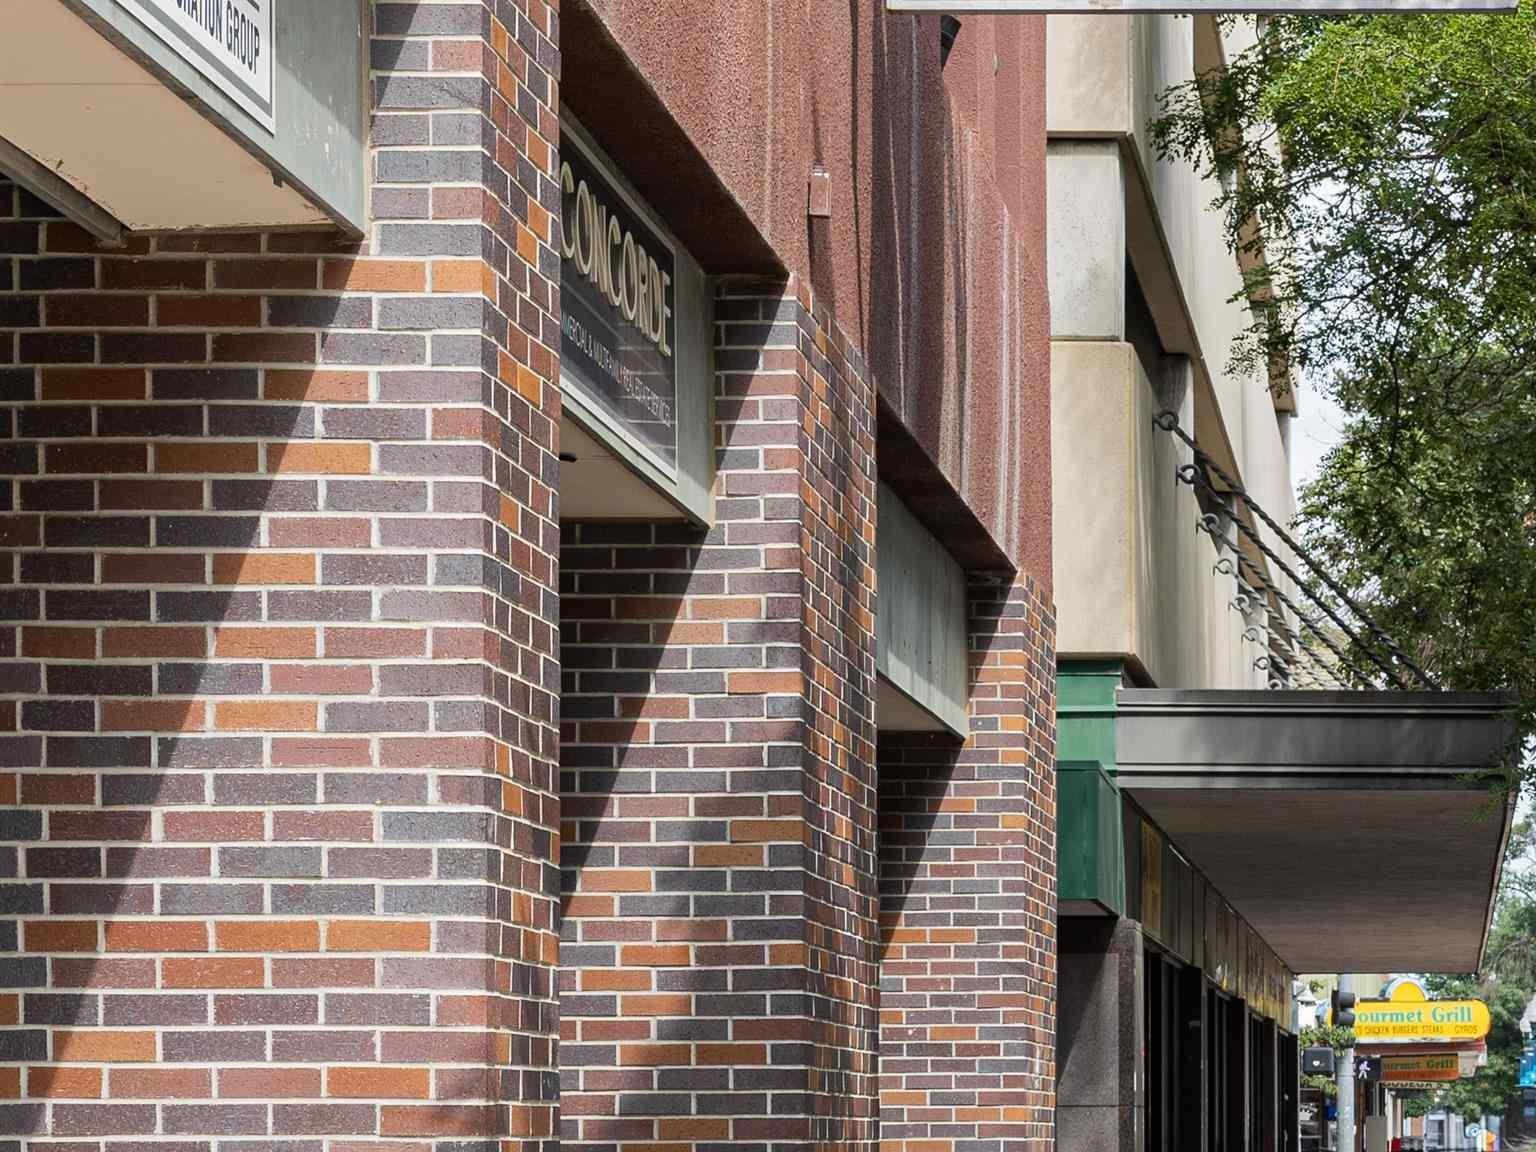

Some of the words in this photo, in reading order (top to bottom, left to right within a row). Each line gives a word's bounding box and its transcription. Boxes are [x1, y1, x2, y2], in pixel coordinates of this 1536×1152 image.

[226, 0, 260, 74] GROUP
[560, 161, 672, 358] CONCORDE
[1355, 1008, 1422, 1023] ourmet
[1431, 1006, 1472, 1023] Grill
